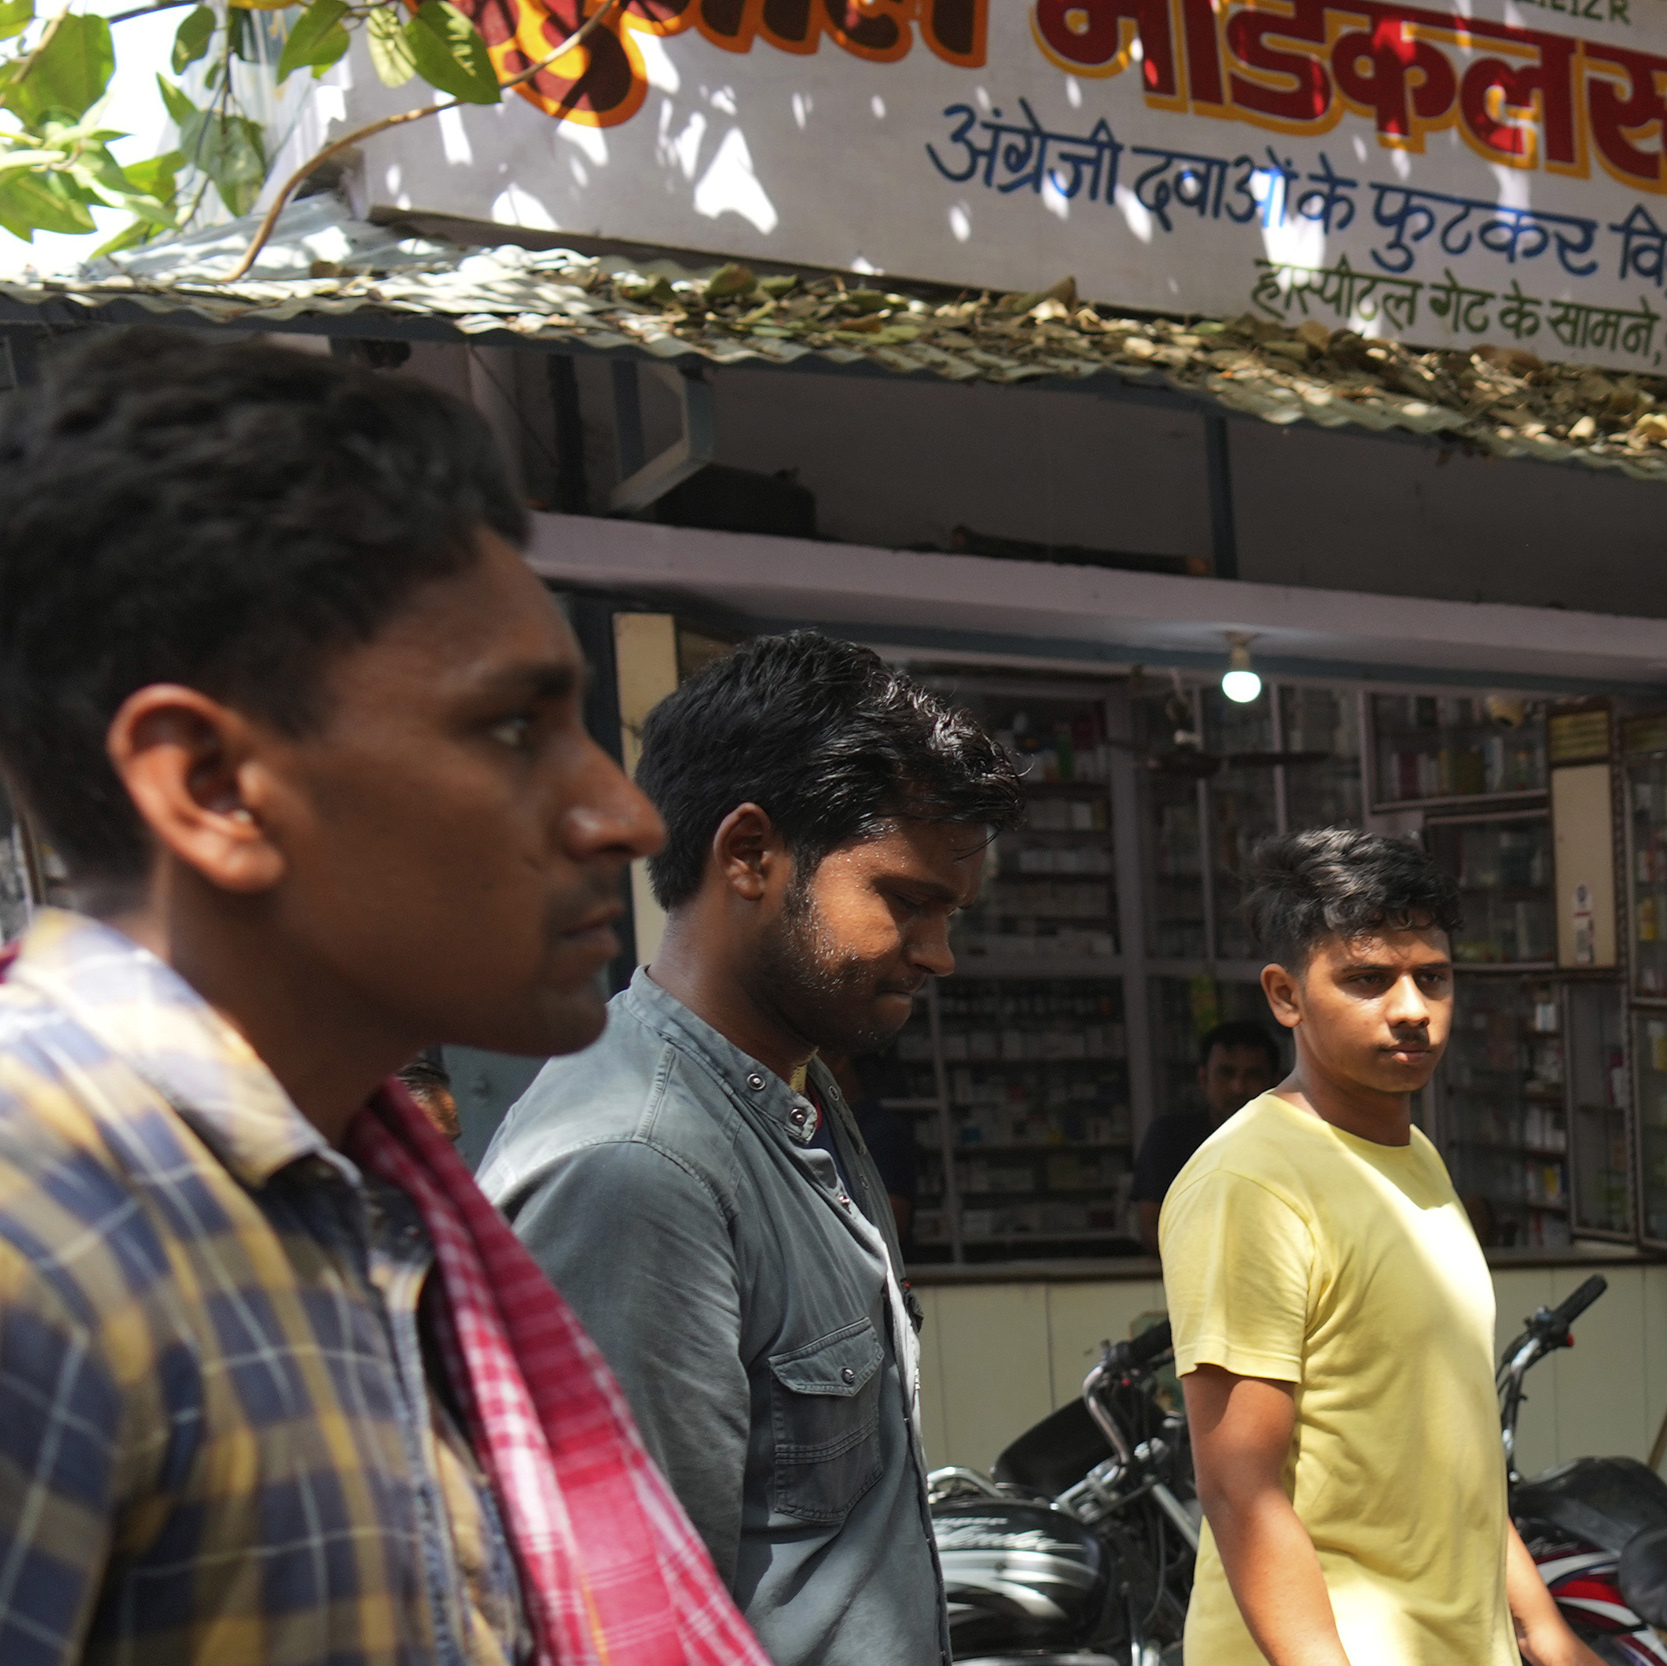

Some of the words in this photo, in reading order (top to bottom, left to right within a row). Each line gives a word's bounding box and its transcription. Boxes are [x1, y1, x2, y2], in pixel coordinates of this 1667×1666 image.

[926, 97, 1124, 206] अंग्रेजी
[1132, 146, 1300, 231] दवाओं
[1299, 152, 1358, 236] के
[1371, 179, 1599, 275] फुटकर
[1430, 268, 1495, 333] गेट
[1502, 280, 1543, 340] के
